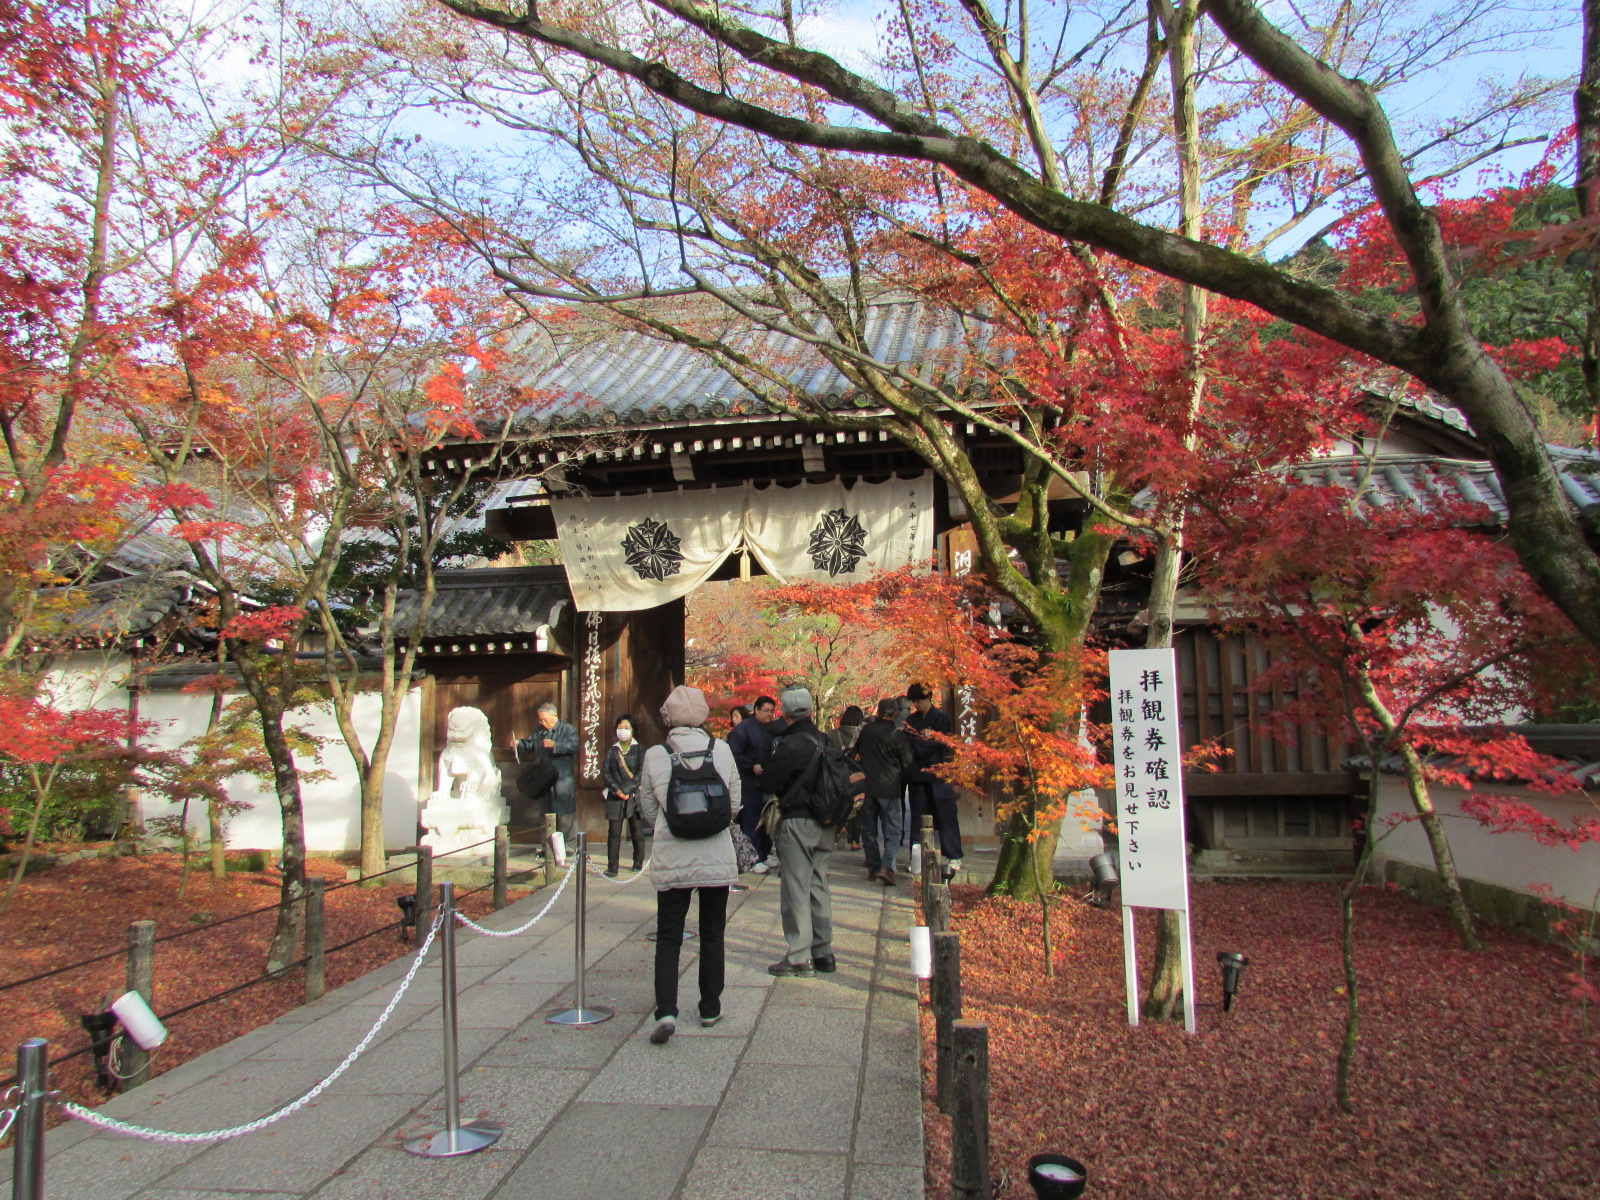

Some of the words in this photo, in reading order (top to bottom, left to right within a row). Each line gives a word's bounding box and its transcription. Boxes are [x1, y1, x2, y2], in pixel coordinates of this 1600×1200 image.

[1117, 689, 1142, 871] 拝観券をお見せ下さい
[1139, 669, 1171, 810] 拝観券確認
